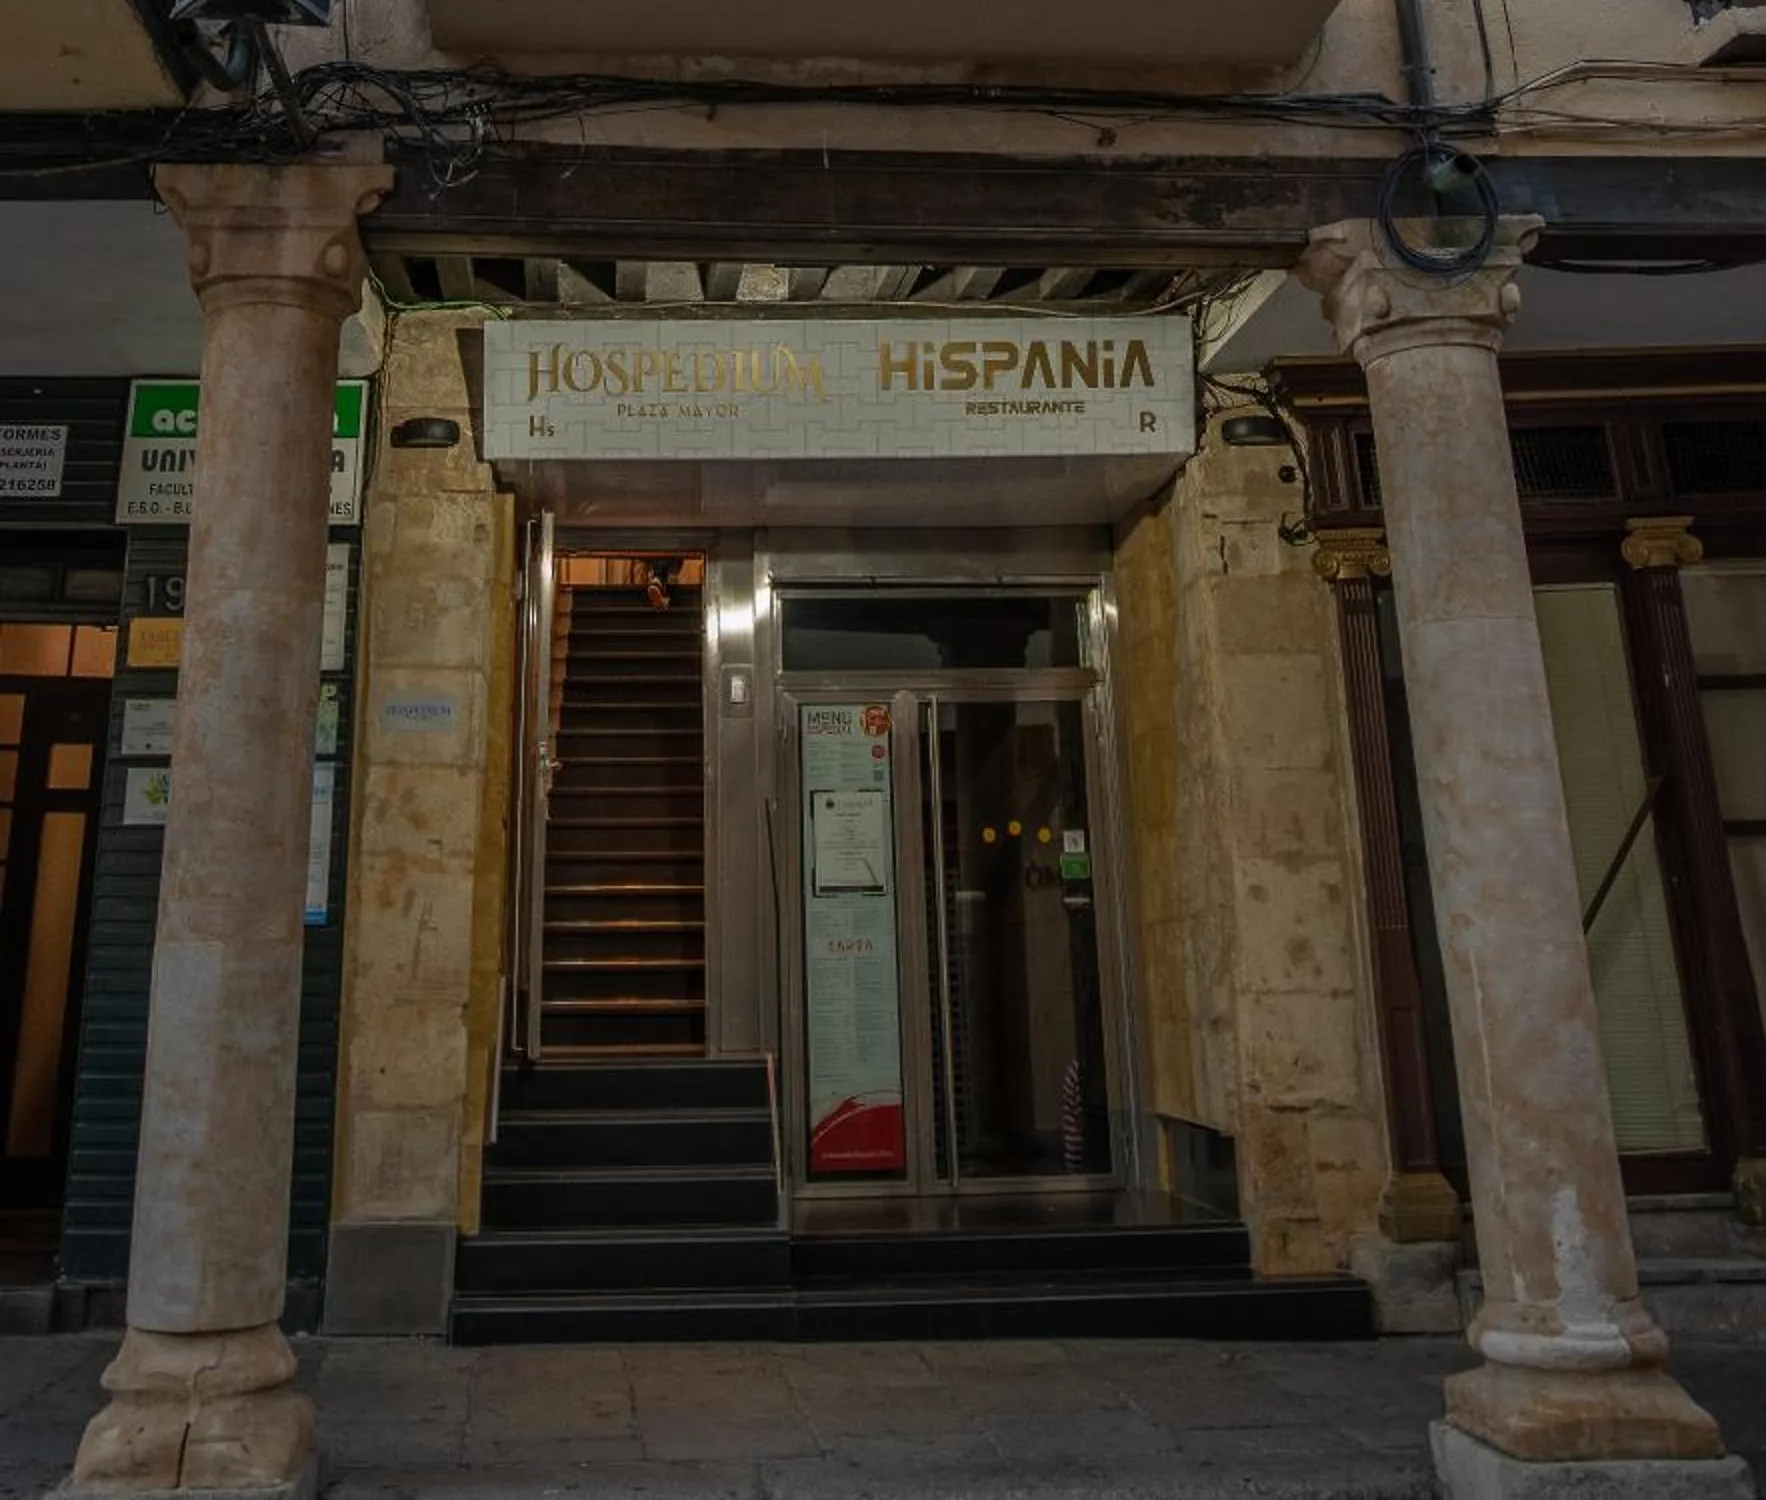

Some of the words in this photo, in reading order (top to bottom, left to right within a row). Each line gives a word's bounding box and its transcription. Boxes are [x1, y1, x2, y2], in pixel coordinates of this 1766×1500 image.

[527, 342, 829, 404] HOSPEDIUM
[617, 402, 669, 418] PLAZA
[679, 402, 740, 418] MAYOR
[965, 400, 1086, 416] RESTAURANTE
[529, 415, 555, 438] Hs
[1139, 411, 1157, 433] R
[0, 427, 61, 441] ORMES
